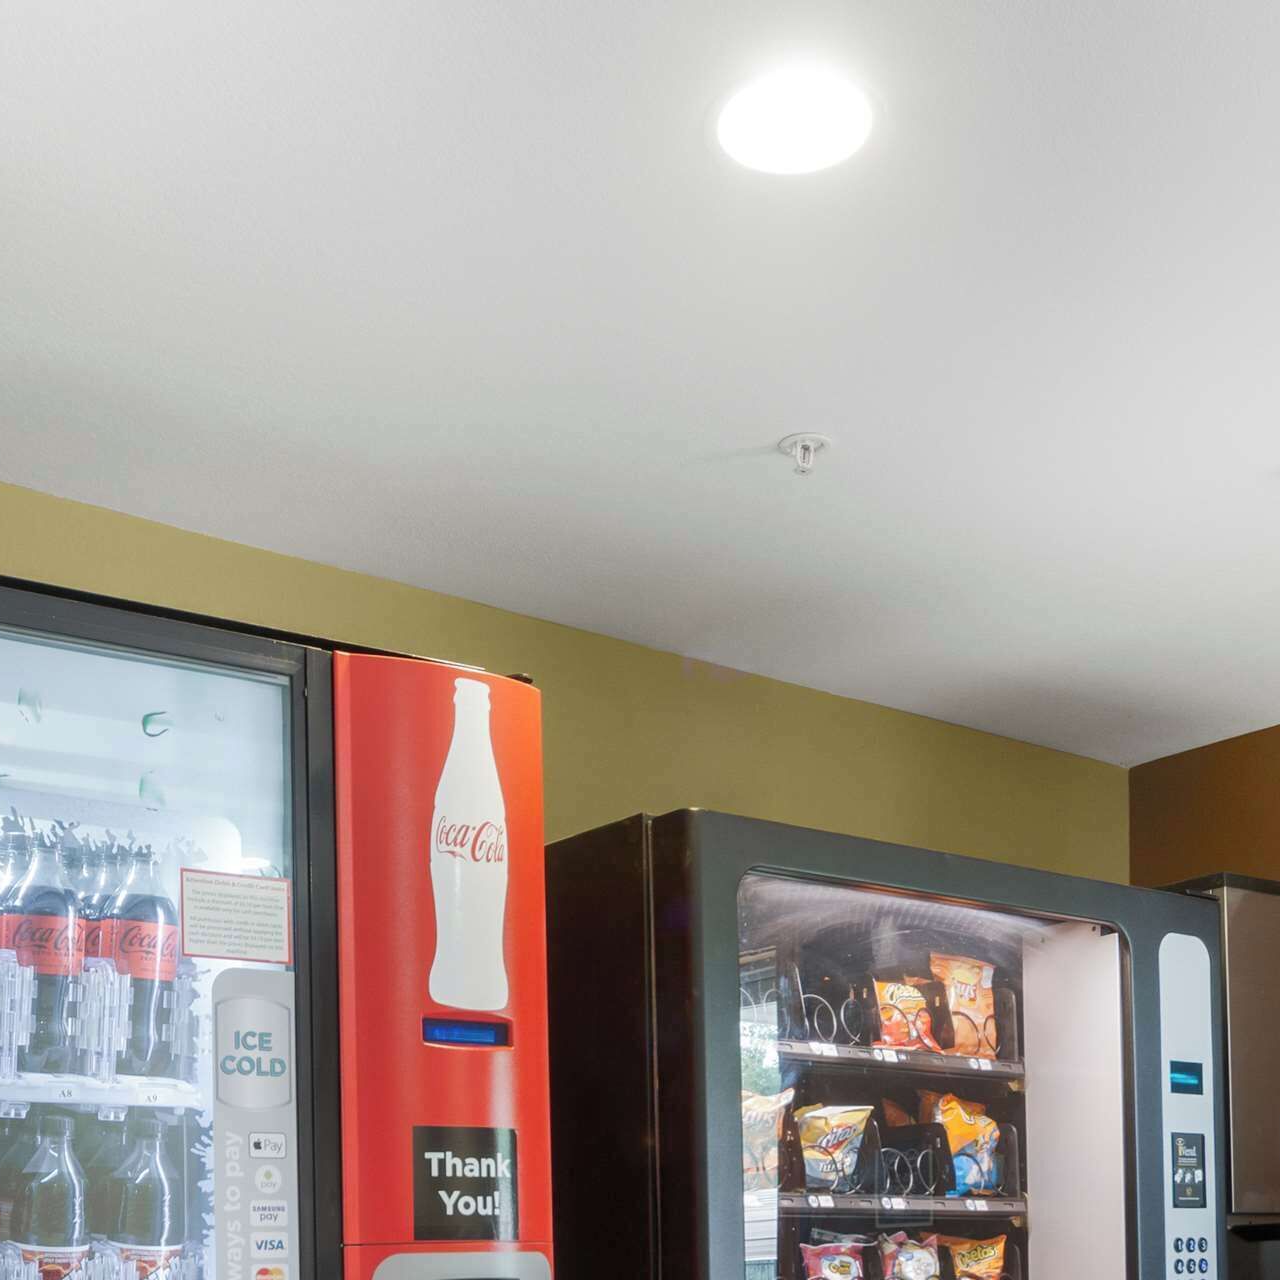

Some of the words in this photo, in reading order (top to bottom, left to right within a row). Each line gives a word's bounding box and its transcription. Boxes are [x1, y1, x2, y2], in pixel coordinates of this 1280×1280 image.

[435, 814, 505, 863] Coca-Cola
[233, 1030, 273, 1052] ICE
[219, 1055, 287, 1078] COLD
[59, 1089, 72, 1098] A8
[263, 1138, 283, 1154] Pay
[424, 1149, 511, 1179] Thank
[438, 1189, 501, 1217] You!
[259, 1213, 279, 1222] pay
[255, 1239, 285, 1251] VISA
